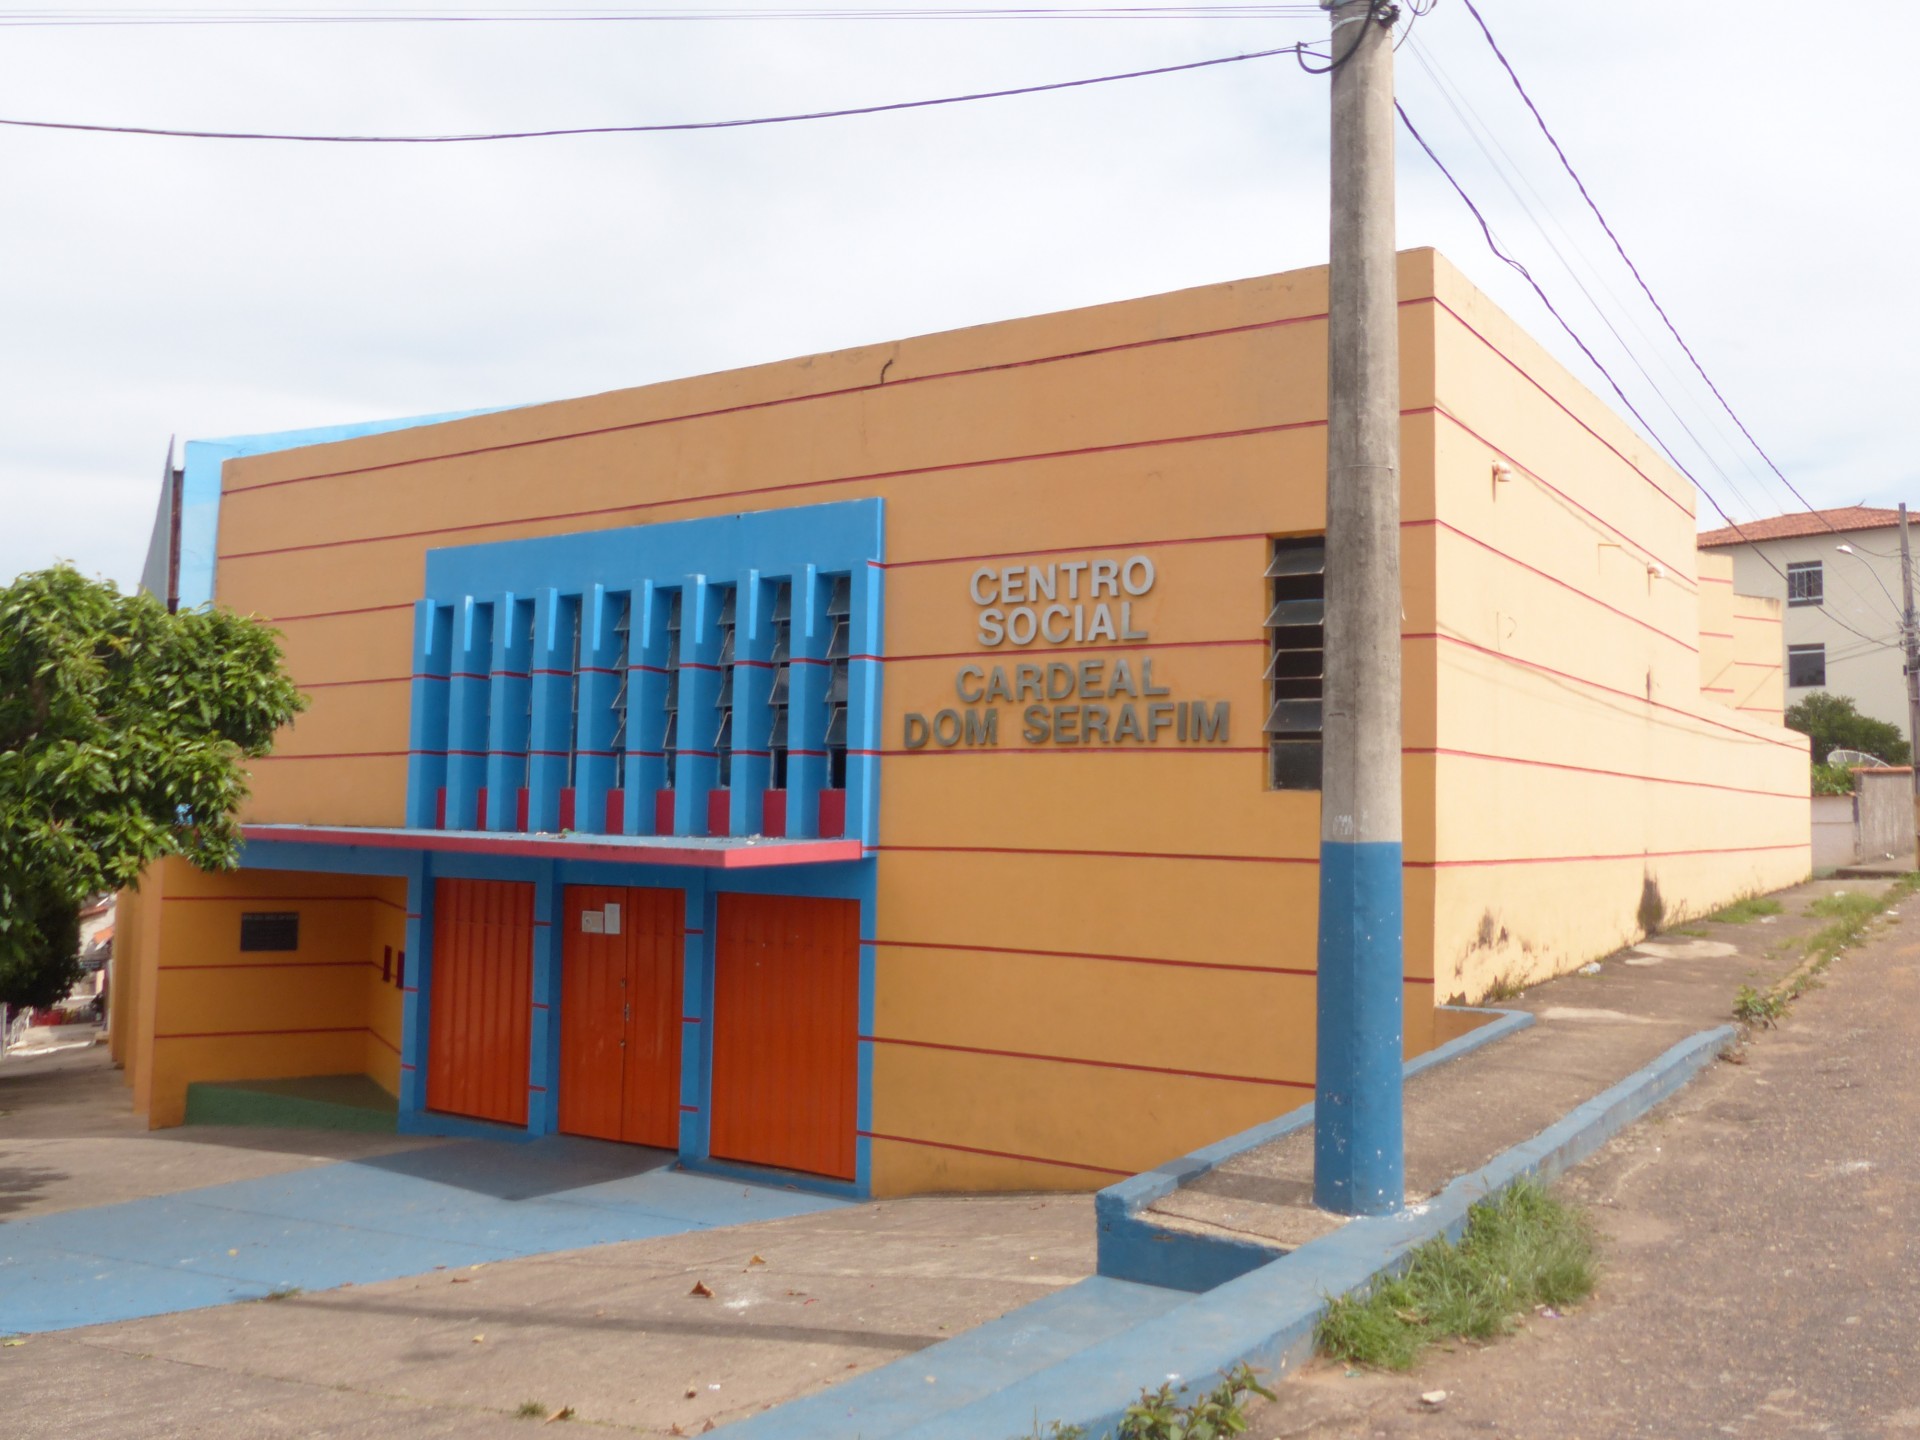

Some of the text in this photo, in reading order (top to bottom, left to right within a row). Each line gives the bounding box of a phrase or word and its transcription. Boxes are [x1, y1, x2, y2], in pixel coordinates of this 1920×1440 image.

[970, 555, 1155, 605] CENTRO
[978, 602, 1149, 646] SOCIAL
[956, 656, 1170, 703] CARDEAL
[904, 701, 1231, 748] DOM SERAFIM
